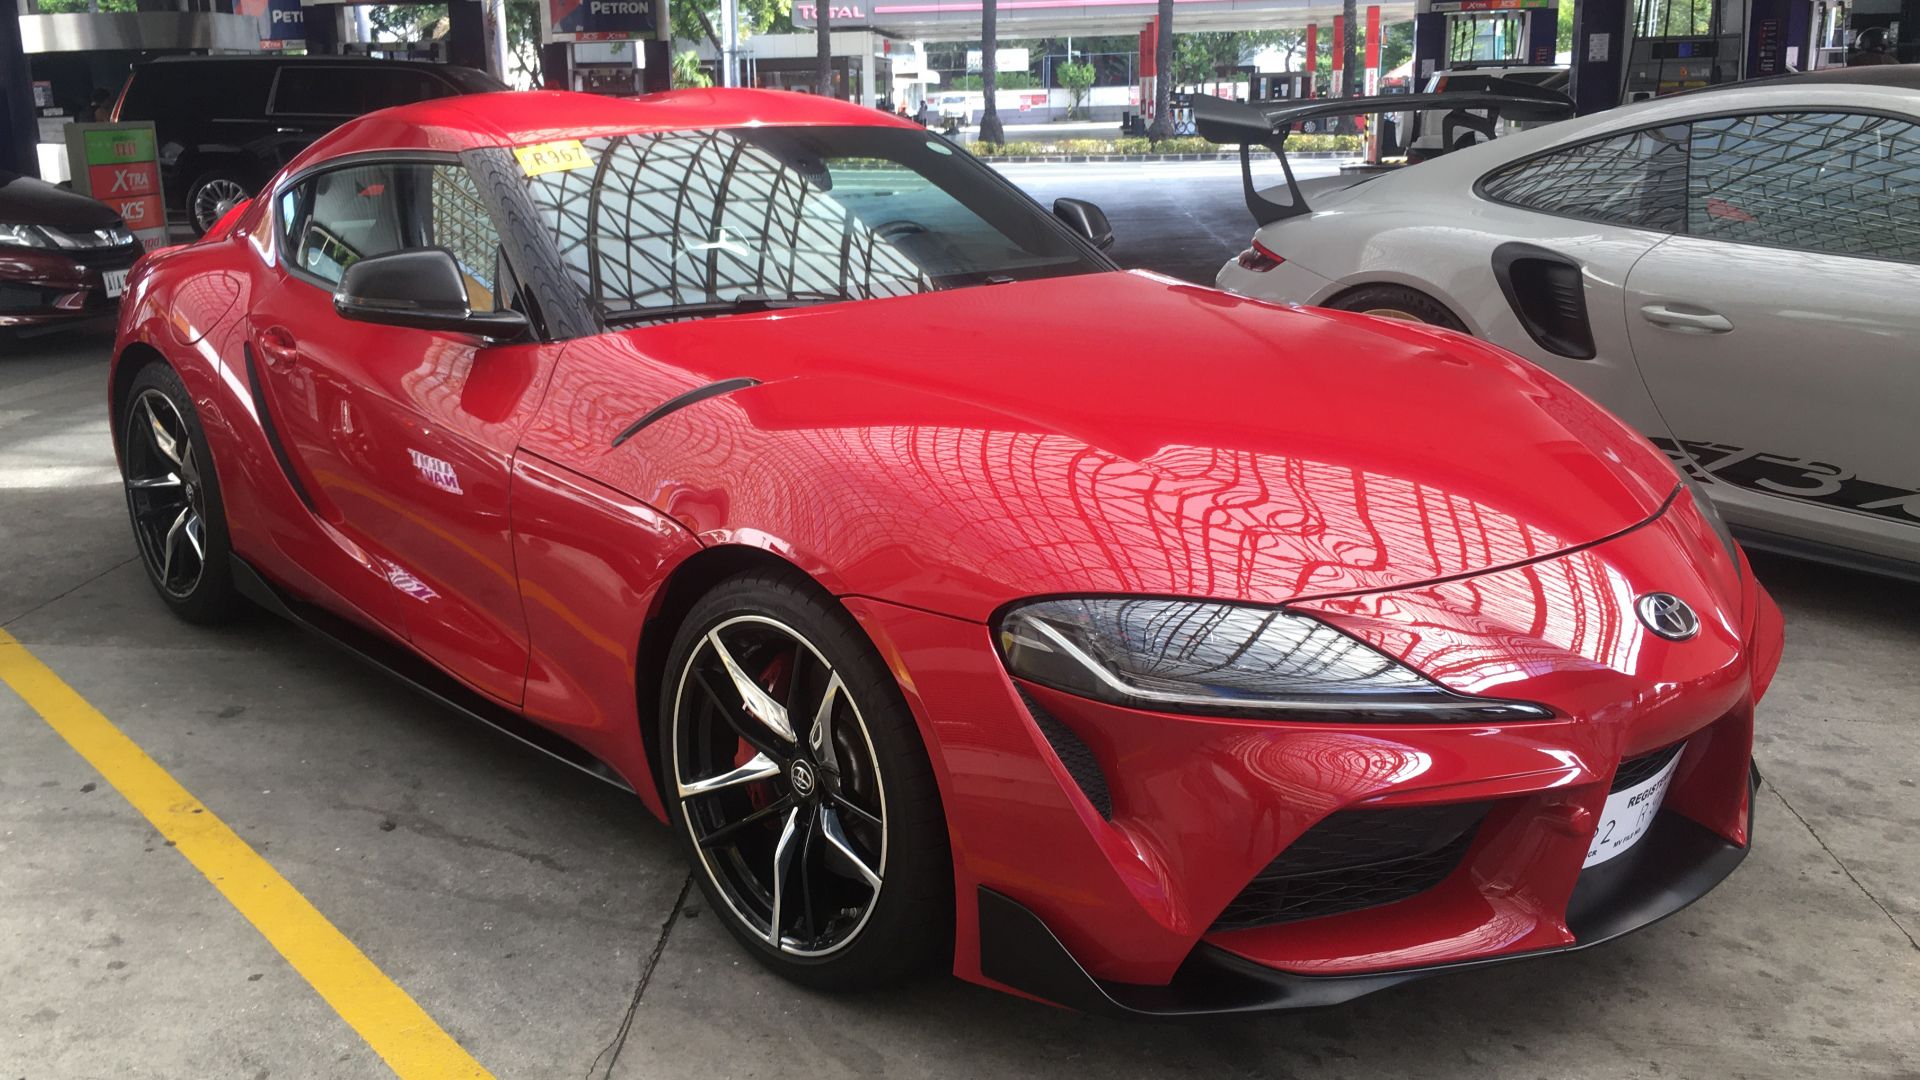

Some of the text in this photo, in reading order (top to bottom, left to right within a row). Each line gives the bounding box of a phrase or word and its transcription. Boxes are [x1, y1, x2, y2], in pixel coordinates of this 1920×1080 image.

[590, 1, 649, 15] PETRON
[533, 147, 582, 166] R967
[111, 169, 149, 193] XTRA
[120, 201, 145, 220] XCS
